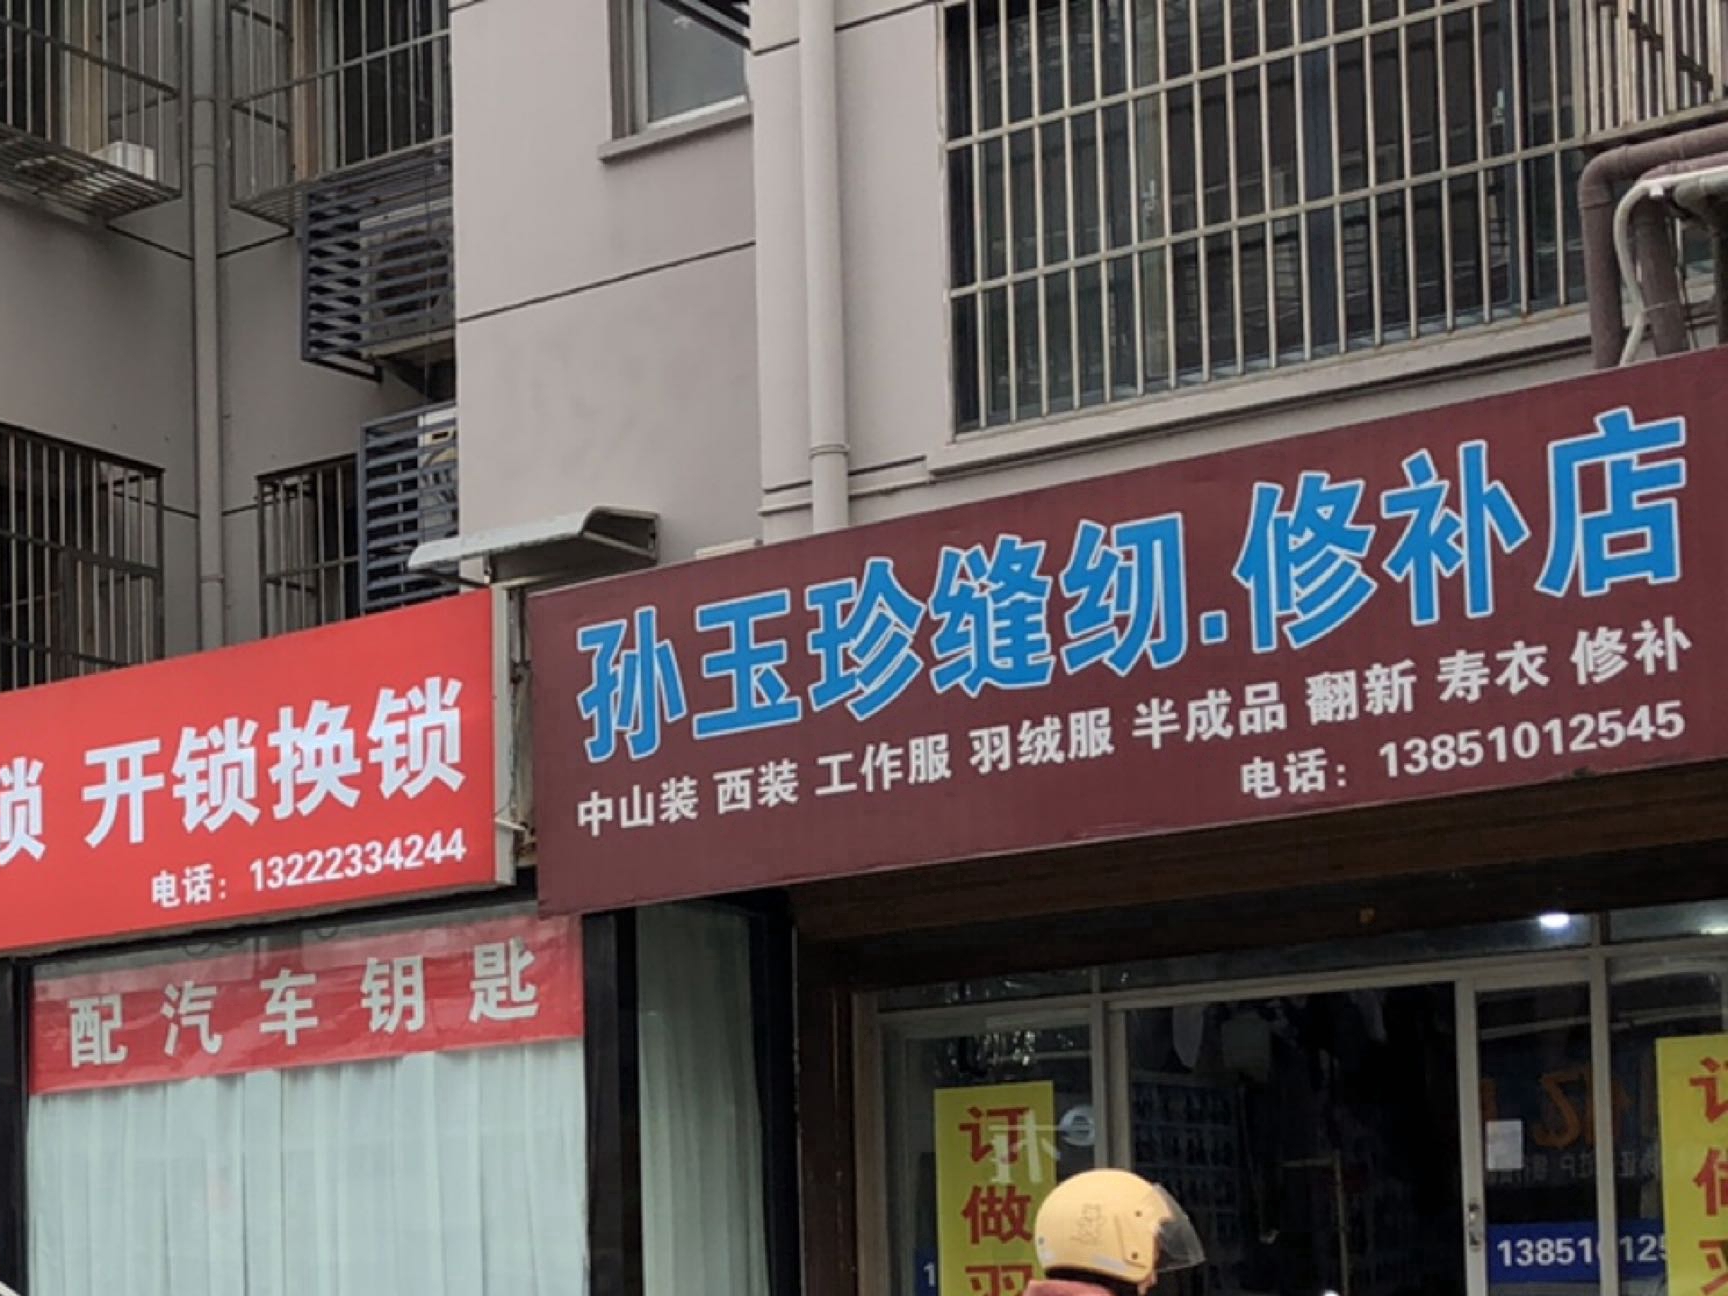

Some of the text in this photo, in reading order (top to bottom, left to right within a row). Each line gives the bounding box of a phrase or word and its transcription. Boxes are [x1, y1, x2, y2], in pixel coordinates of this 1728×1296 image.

[575, 405, 1689, 764] 孙玉珍缝纫.修补店
[81, 675, 465, 848] 开锁换锁
[577, 616, 1692, 838] 中山装 西装 工作服 羽绒服 半成品 翻新 寿衣 修补
[1240, 699, 1686, 800] 电话： 13851012545
[150, 828, 466, 908] 电话： 13222334244
[68, 936, 539, 1067] 配汽车钥匙
